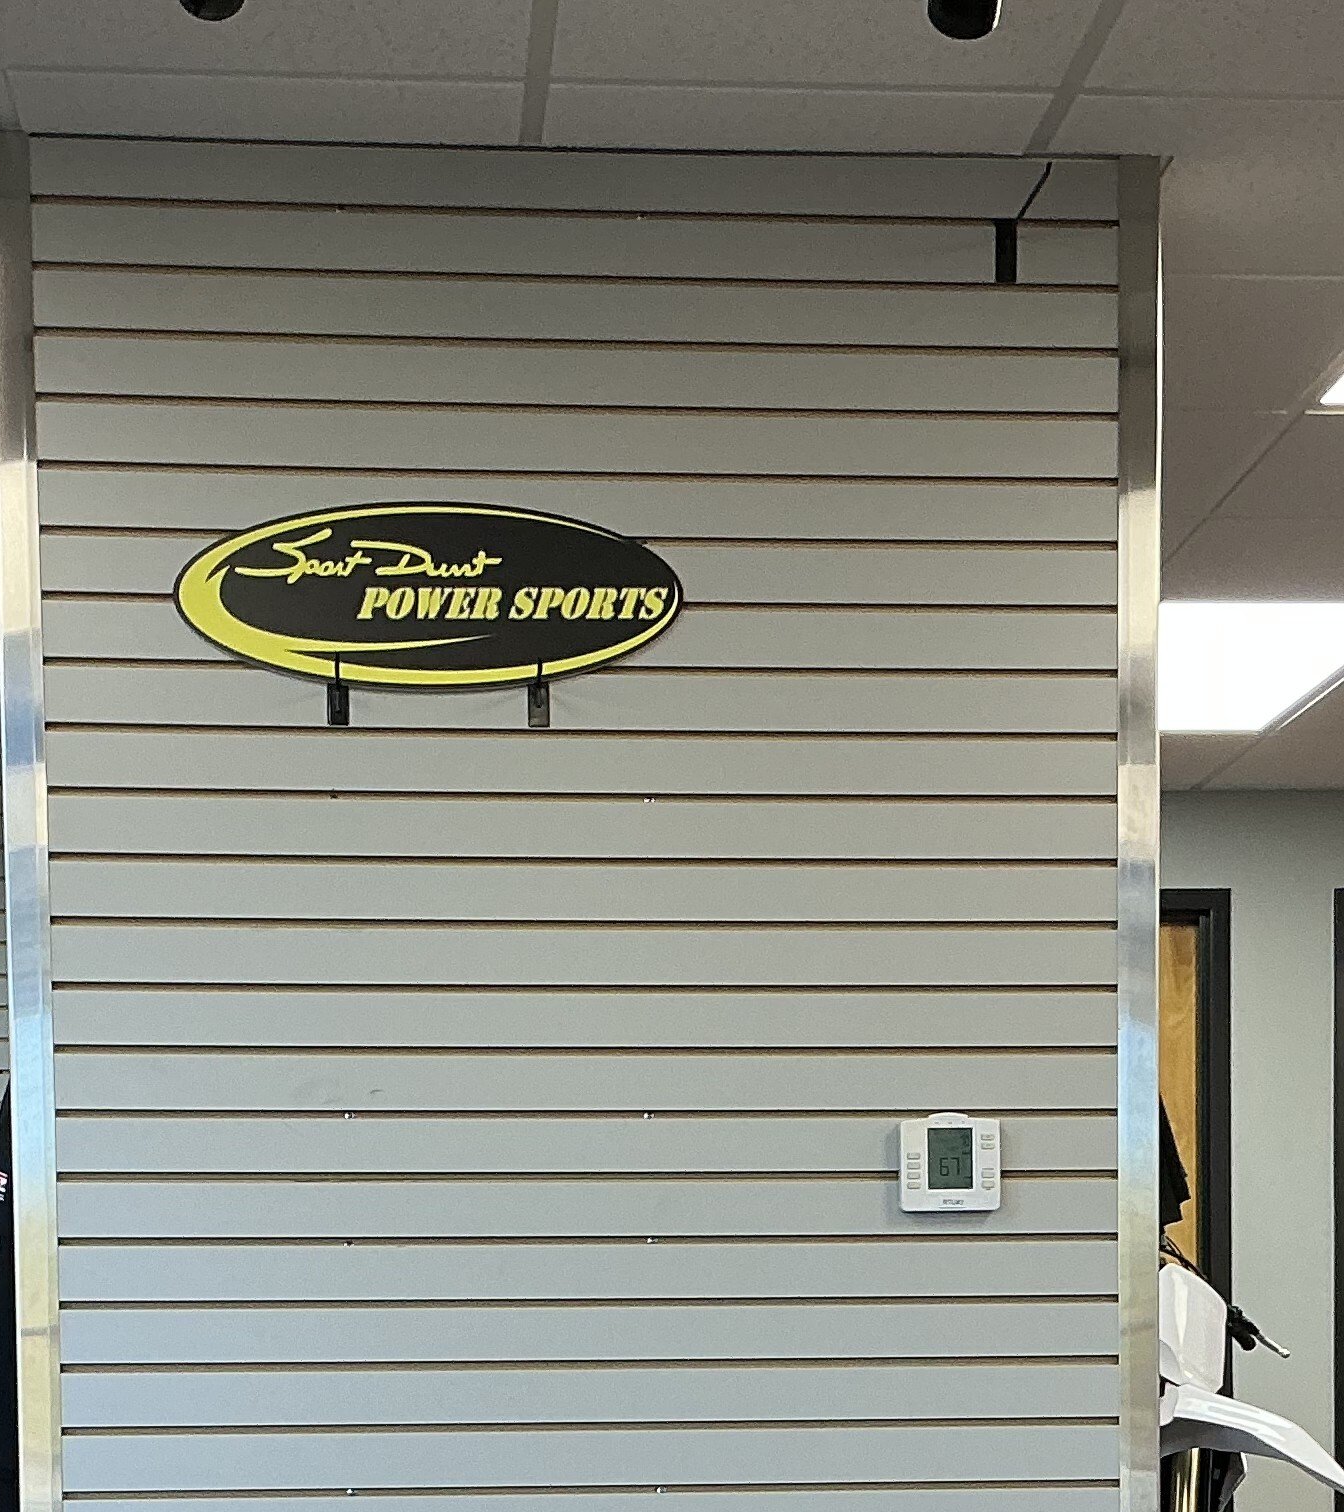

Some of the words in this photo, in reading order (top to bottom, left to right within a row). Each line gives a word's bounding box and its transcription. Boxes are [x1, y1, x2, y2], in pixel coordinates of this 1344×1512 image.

[356, 586, 500, 621] POWER
[508, 586, 669, 621] SPORTS
[939, 1157, 961, 1177] 67
